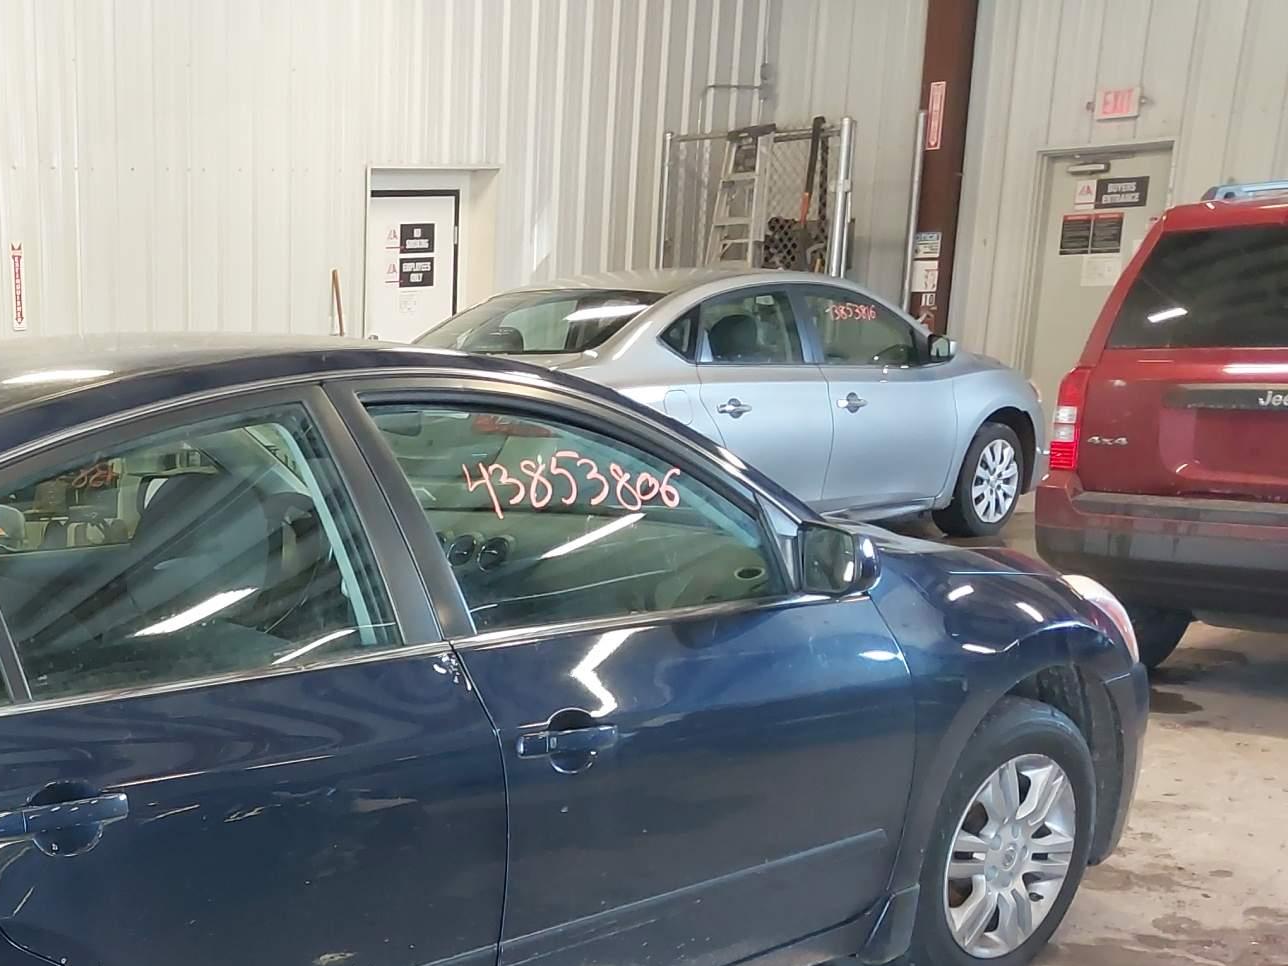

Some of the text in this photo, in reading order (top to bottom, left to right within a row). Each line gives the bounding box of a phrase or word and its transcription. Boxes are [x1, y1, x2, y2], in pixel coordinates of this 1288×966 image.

[1102, 88, 1134, 113] EXIT
[1258, 390, 1288, 406] Jee
[462, 450, 681, 520] 43853806
